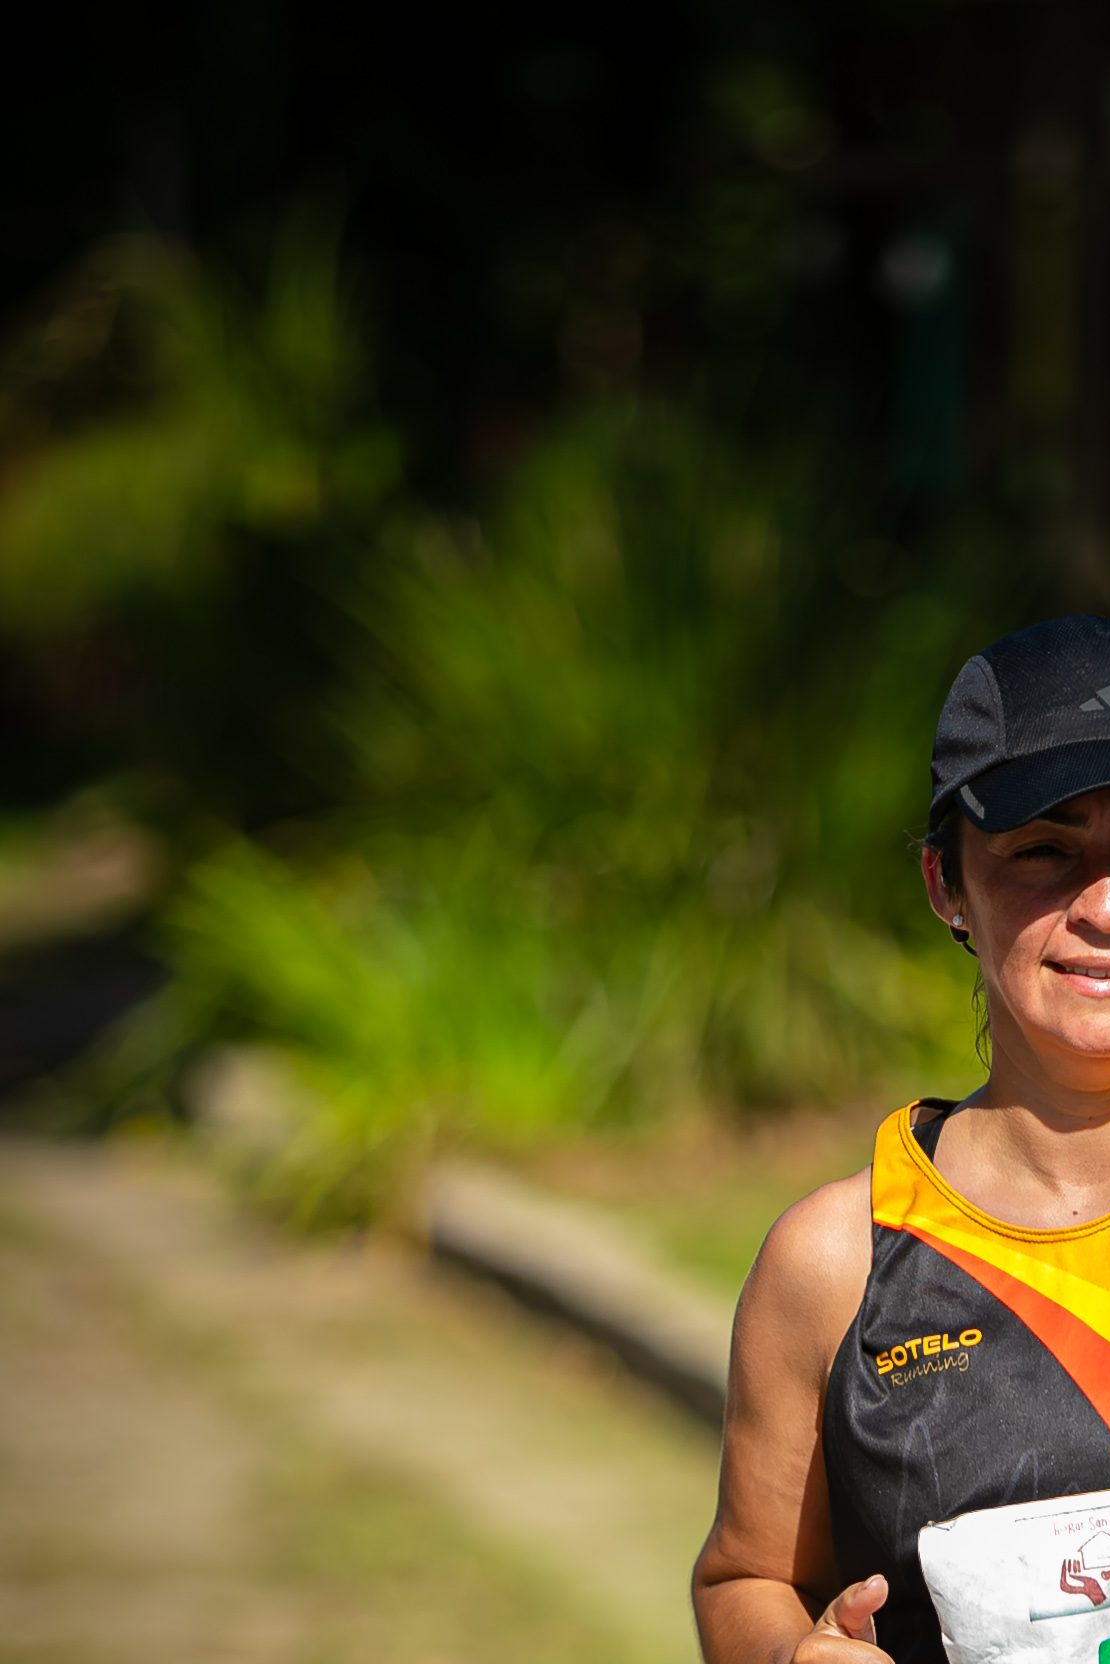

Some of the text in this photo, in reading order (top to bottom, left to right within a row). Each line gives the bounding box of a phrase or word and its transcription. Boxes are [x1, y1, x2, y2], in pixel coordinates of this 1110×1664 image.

[876, 1328, 982, 1375] SOTELO
[890, 1351, 969, 1387] Running
[1088, 1516, 1108, 1531] San
